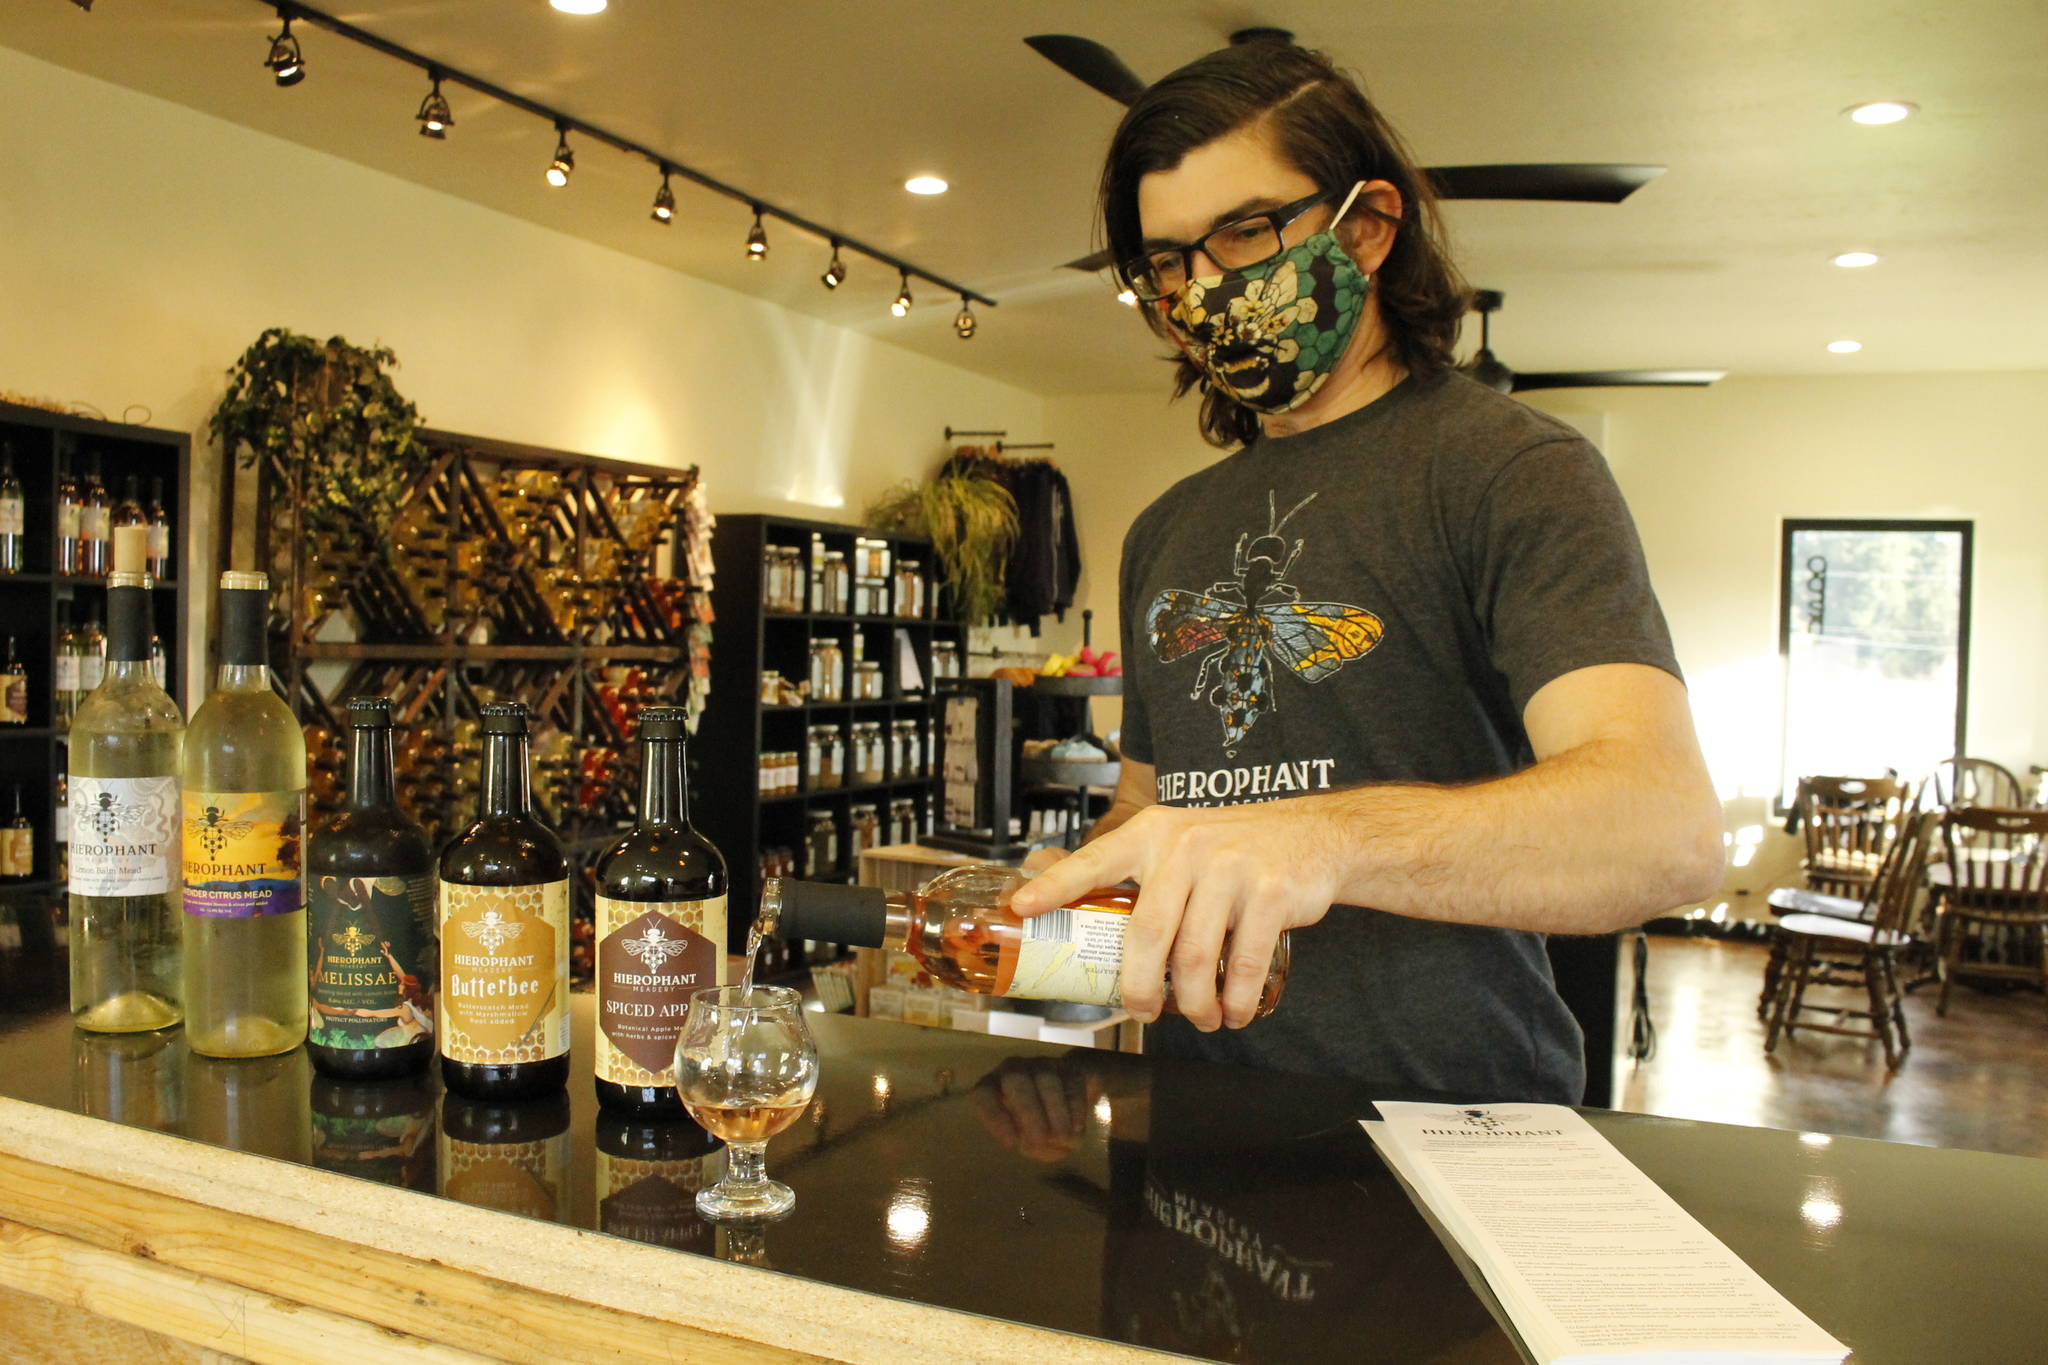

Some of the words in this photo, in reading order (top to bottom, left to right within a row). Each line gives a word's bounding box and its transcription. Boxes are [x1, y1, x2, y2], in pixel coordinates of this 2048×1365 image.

[1157, 758, 1336, 803] HIEROPHANT
[70, 843, 158, 856] HIEROPHANT
[184, 888, 208, 899] ENDER
[209, 890, 243, 900] CITRUS
[244, 889, 273, 900] MEAD
[328, 955, 383, 965] HIEROPHANT
[454, 953, 535, 967] HIEROPHANT
[319, 971, 397, 986] MELISSAE
[451, 973, 539, 998] Butterbee
[613, 972, 697, 986] HIEROPHANT
[606, 999, 655, 1017] SPICED
[659, 1003, 689, 1017] APP
[617, 1023, 649, 1032] Botanical
[1421, 1127, 1566, 1138] HIEROPHANT
